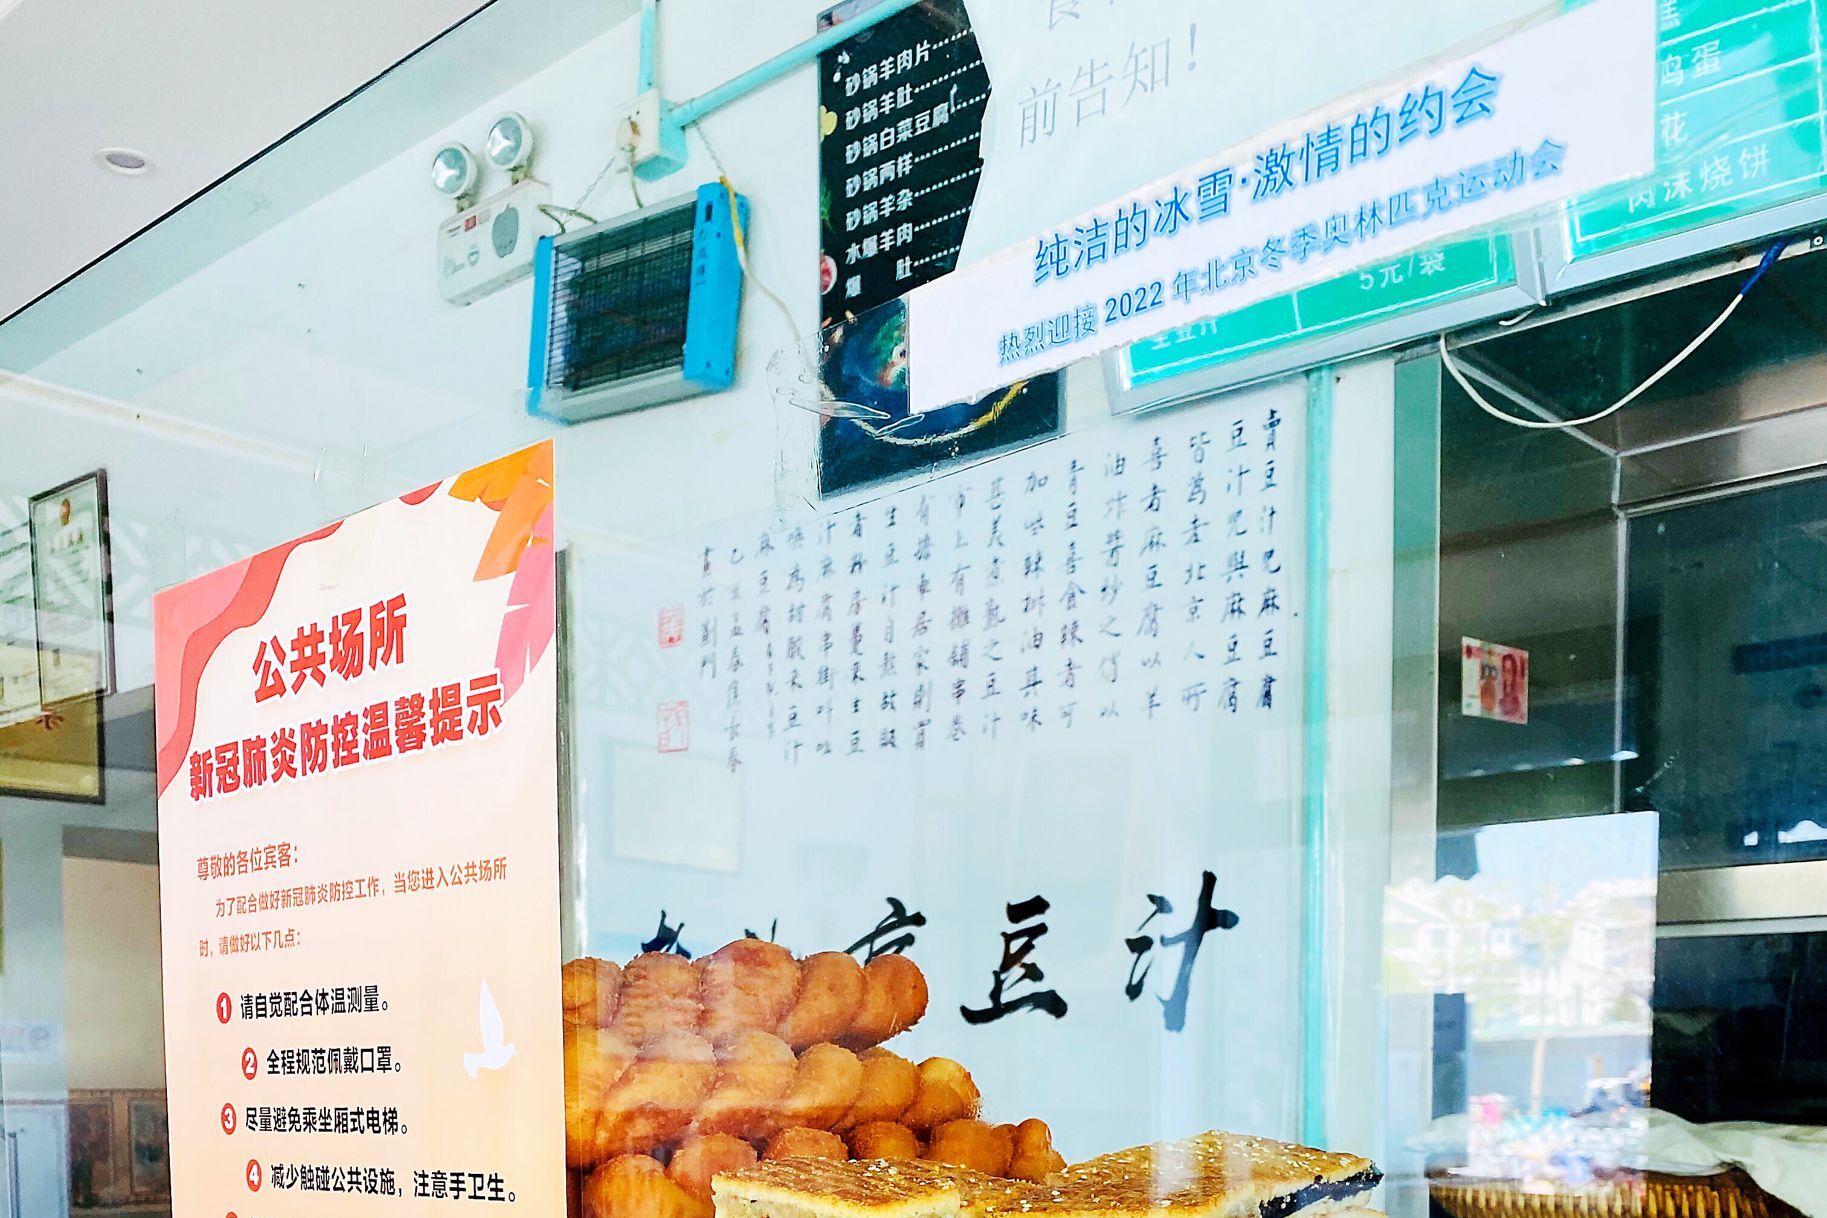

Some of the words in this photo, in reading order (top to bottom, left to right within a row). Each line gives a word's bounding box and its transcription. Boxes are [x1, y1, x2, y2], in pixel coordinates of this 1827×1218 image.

[845, 39, 931, 97] 砂锅羊肉片
[845, 101, 949, 165] 砂锅白菜豆腐
[253, 594, 407, 703] 公共场所
[190, 674, 502, 801] 新冠肺炎防控温馨提示
[197, 841, 299, 881] 尊敬的各位宾客：
[240, 985, 389, 1020] 请自觉配合体温测量。
[266, 1046, 402, 1076] 全程规范佩戴口罩。
[245, 1106, 408, 1135] 尽量避免乘坐厢式电梯。
[270, 1164, 516, 1202] 减少触碰公共设施，注意手卫生。
